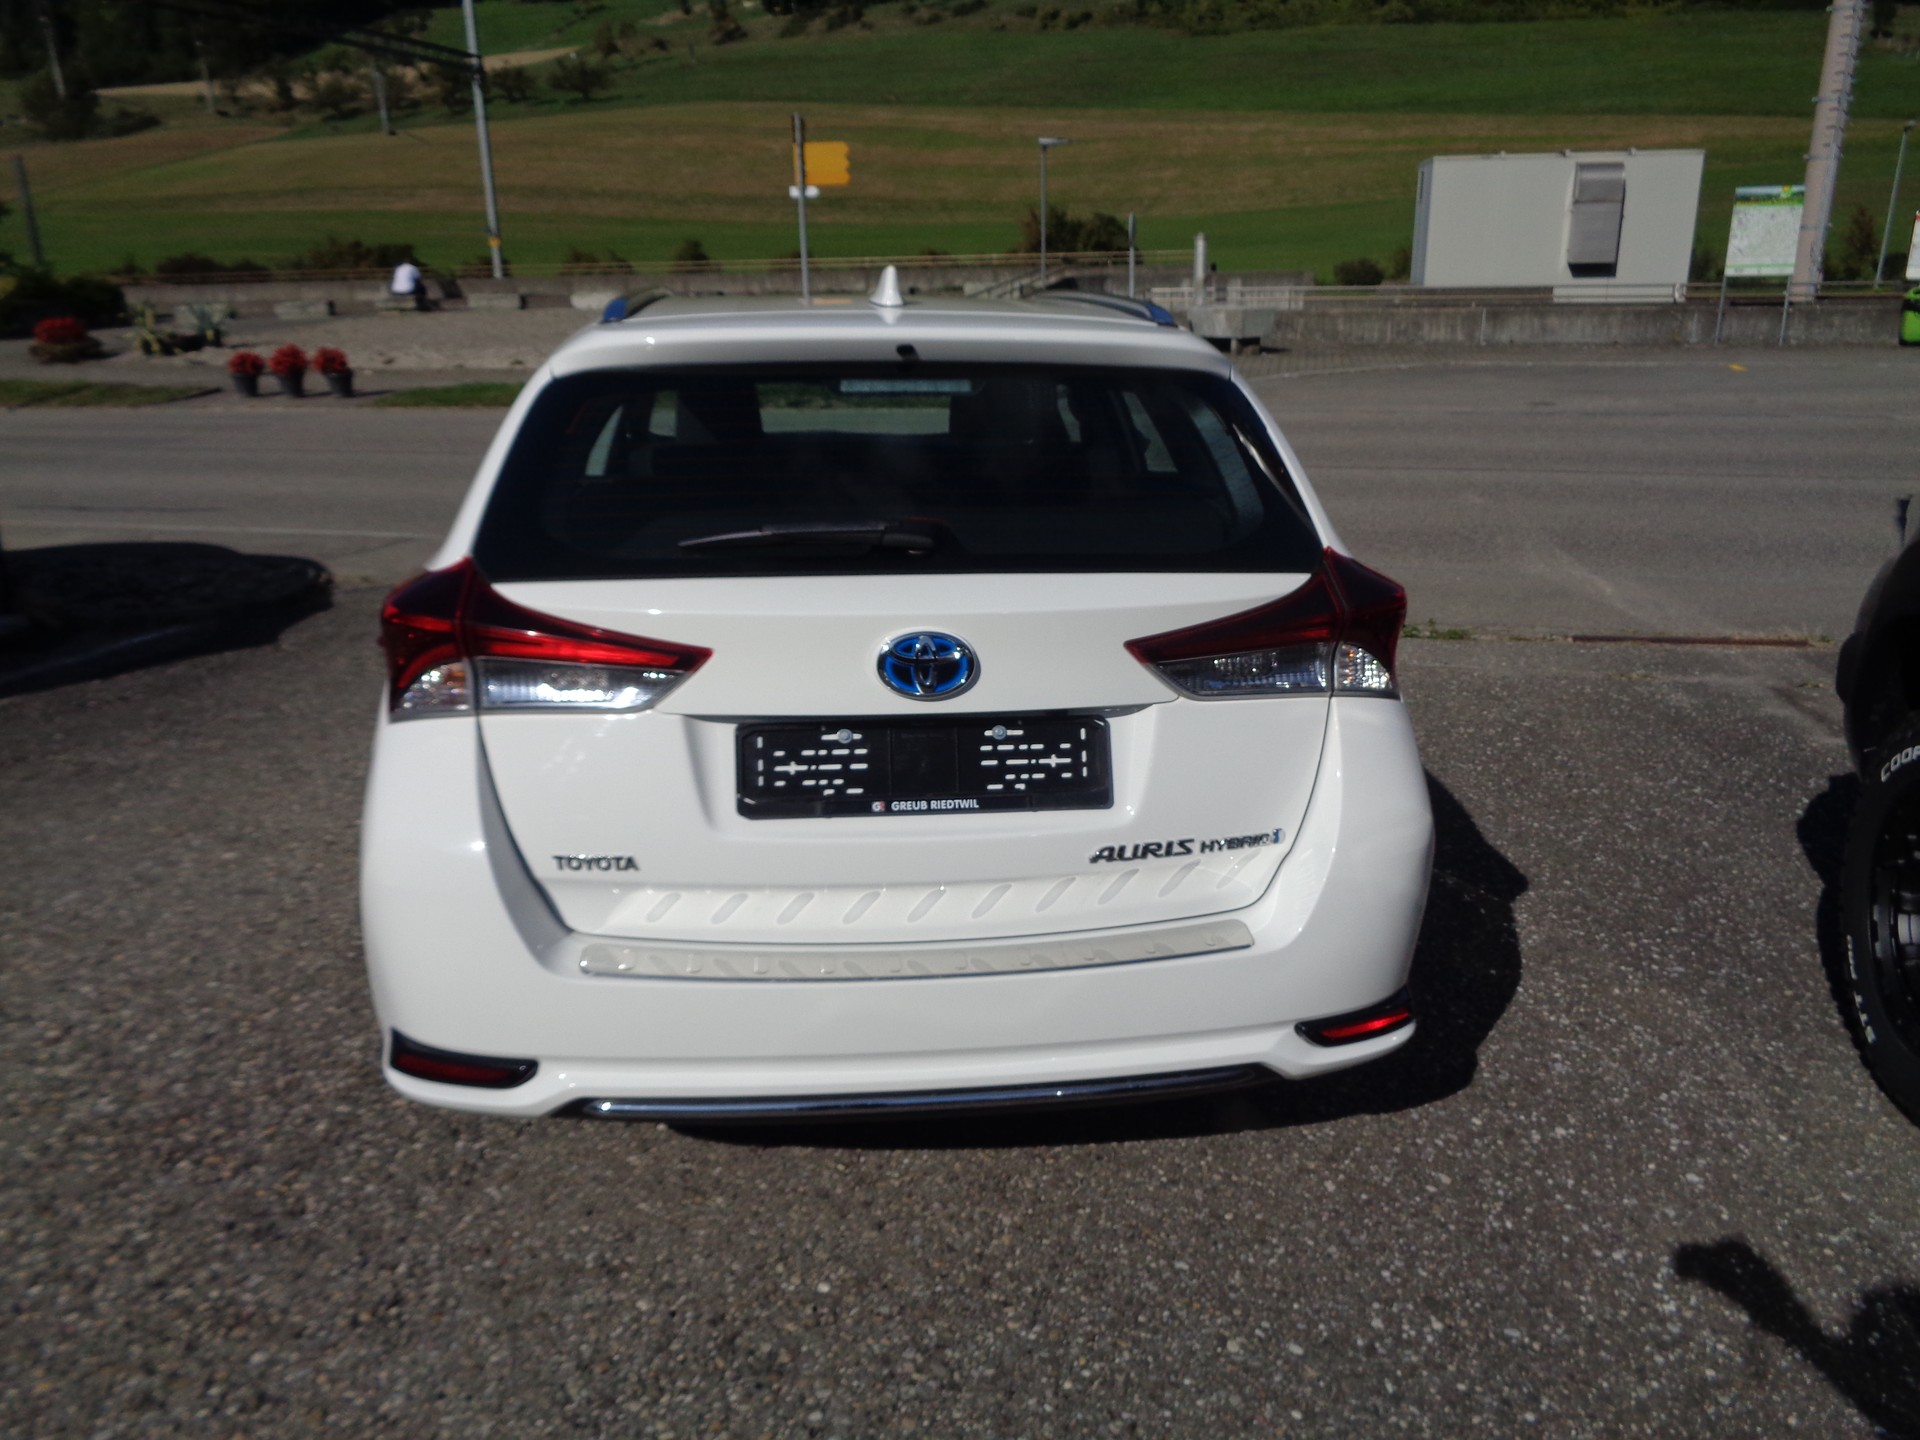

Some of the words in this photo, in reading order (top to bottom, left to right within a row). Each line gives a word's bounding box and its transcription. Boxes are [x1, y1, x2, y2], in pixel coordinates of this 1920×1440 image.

[891, 800, 928, 811] GREUB
[930, 799, 979, 810] RIEDTWIL
[1089, 838, 1195, 864] AURIS
[1200, 833, 1271, 854] HYBRID
[552, 854, 640, 871] TOYOTA
